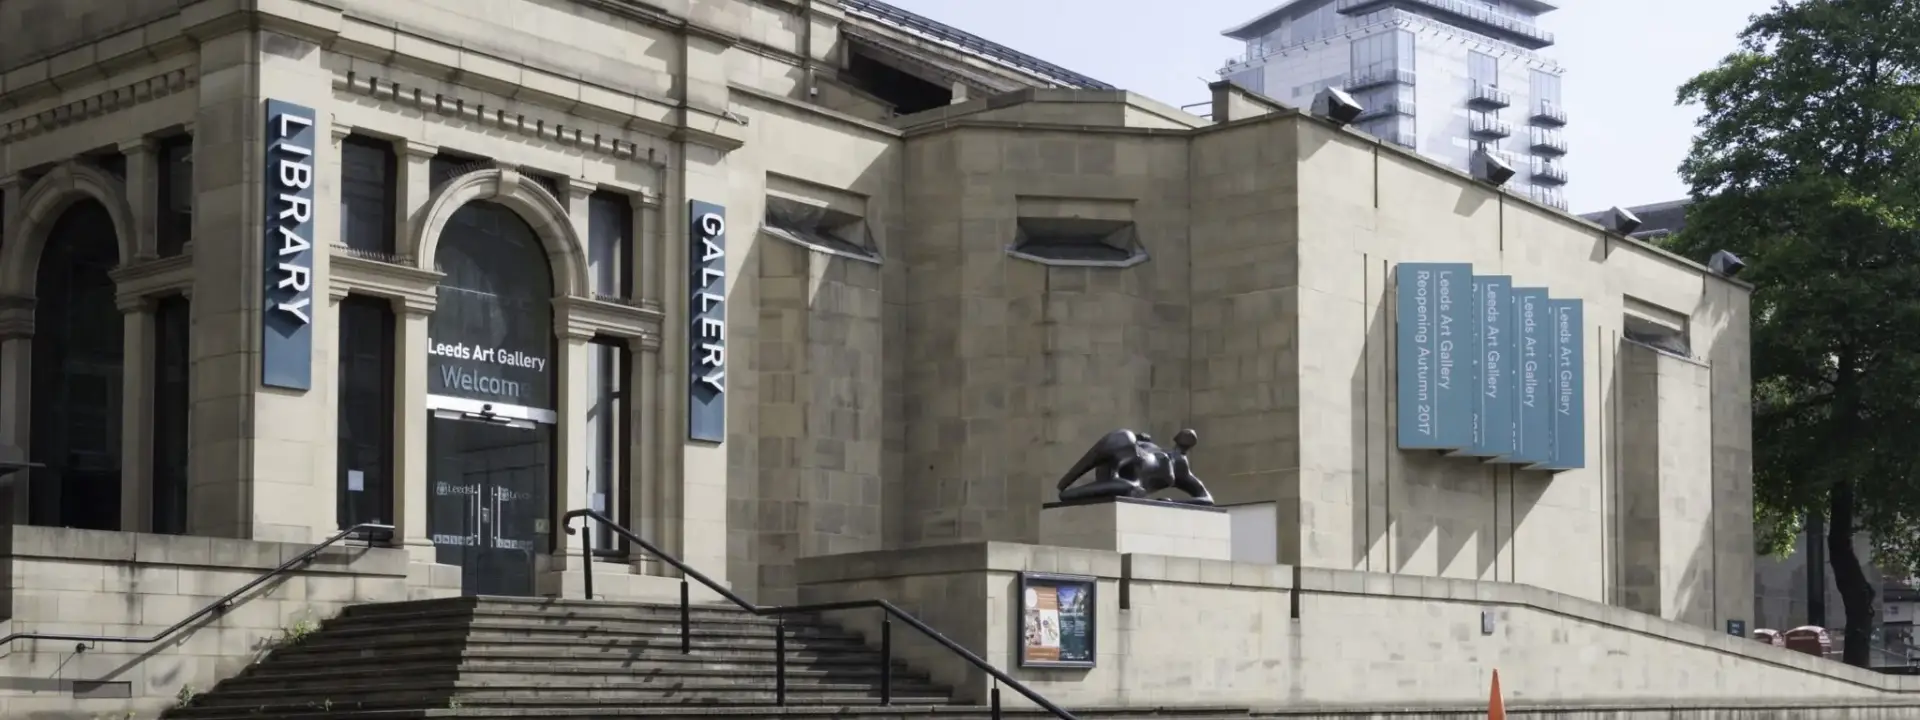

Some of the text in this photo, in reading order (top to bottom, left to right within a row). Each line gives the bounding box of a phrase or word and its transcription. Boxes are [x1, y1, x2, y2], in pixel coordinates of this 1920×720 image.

[278, 112, 312, 325] LIBRARY
[428, 337, 546, 372] Leeds Art Gallery
[702, 212, 725, 393] GALLERY
[1414, 270, 1431, 436] Reopening Autumn 2017
[1438, 270, 1453, 389] Leeds Art Gallery
[1485, 283, 1500, 399] Leeds Art Gallery
[1523, 295, 1538, 408] Leeds Art Gallery
[1558, 306, 1573, 416] Leeds Art Gallery
